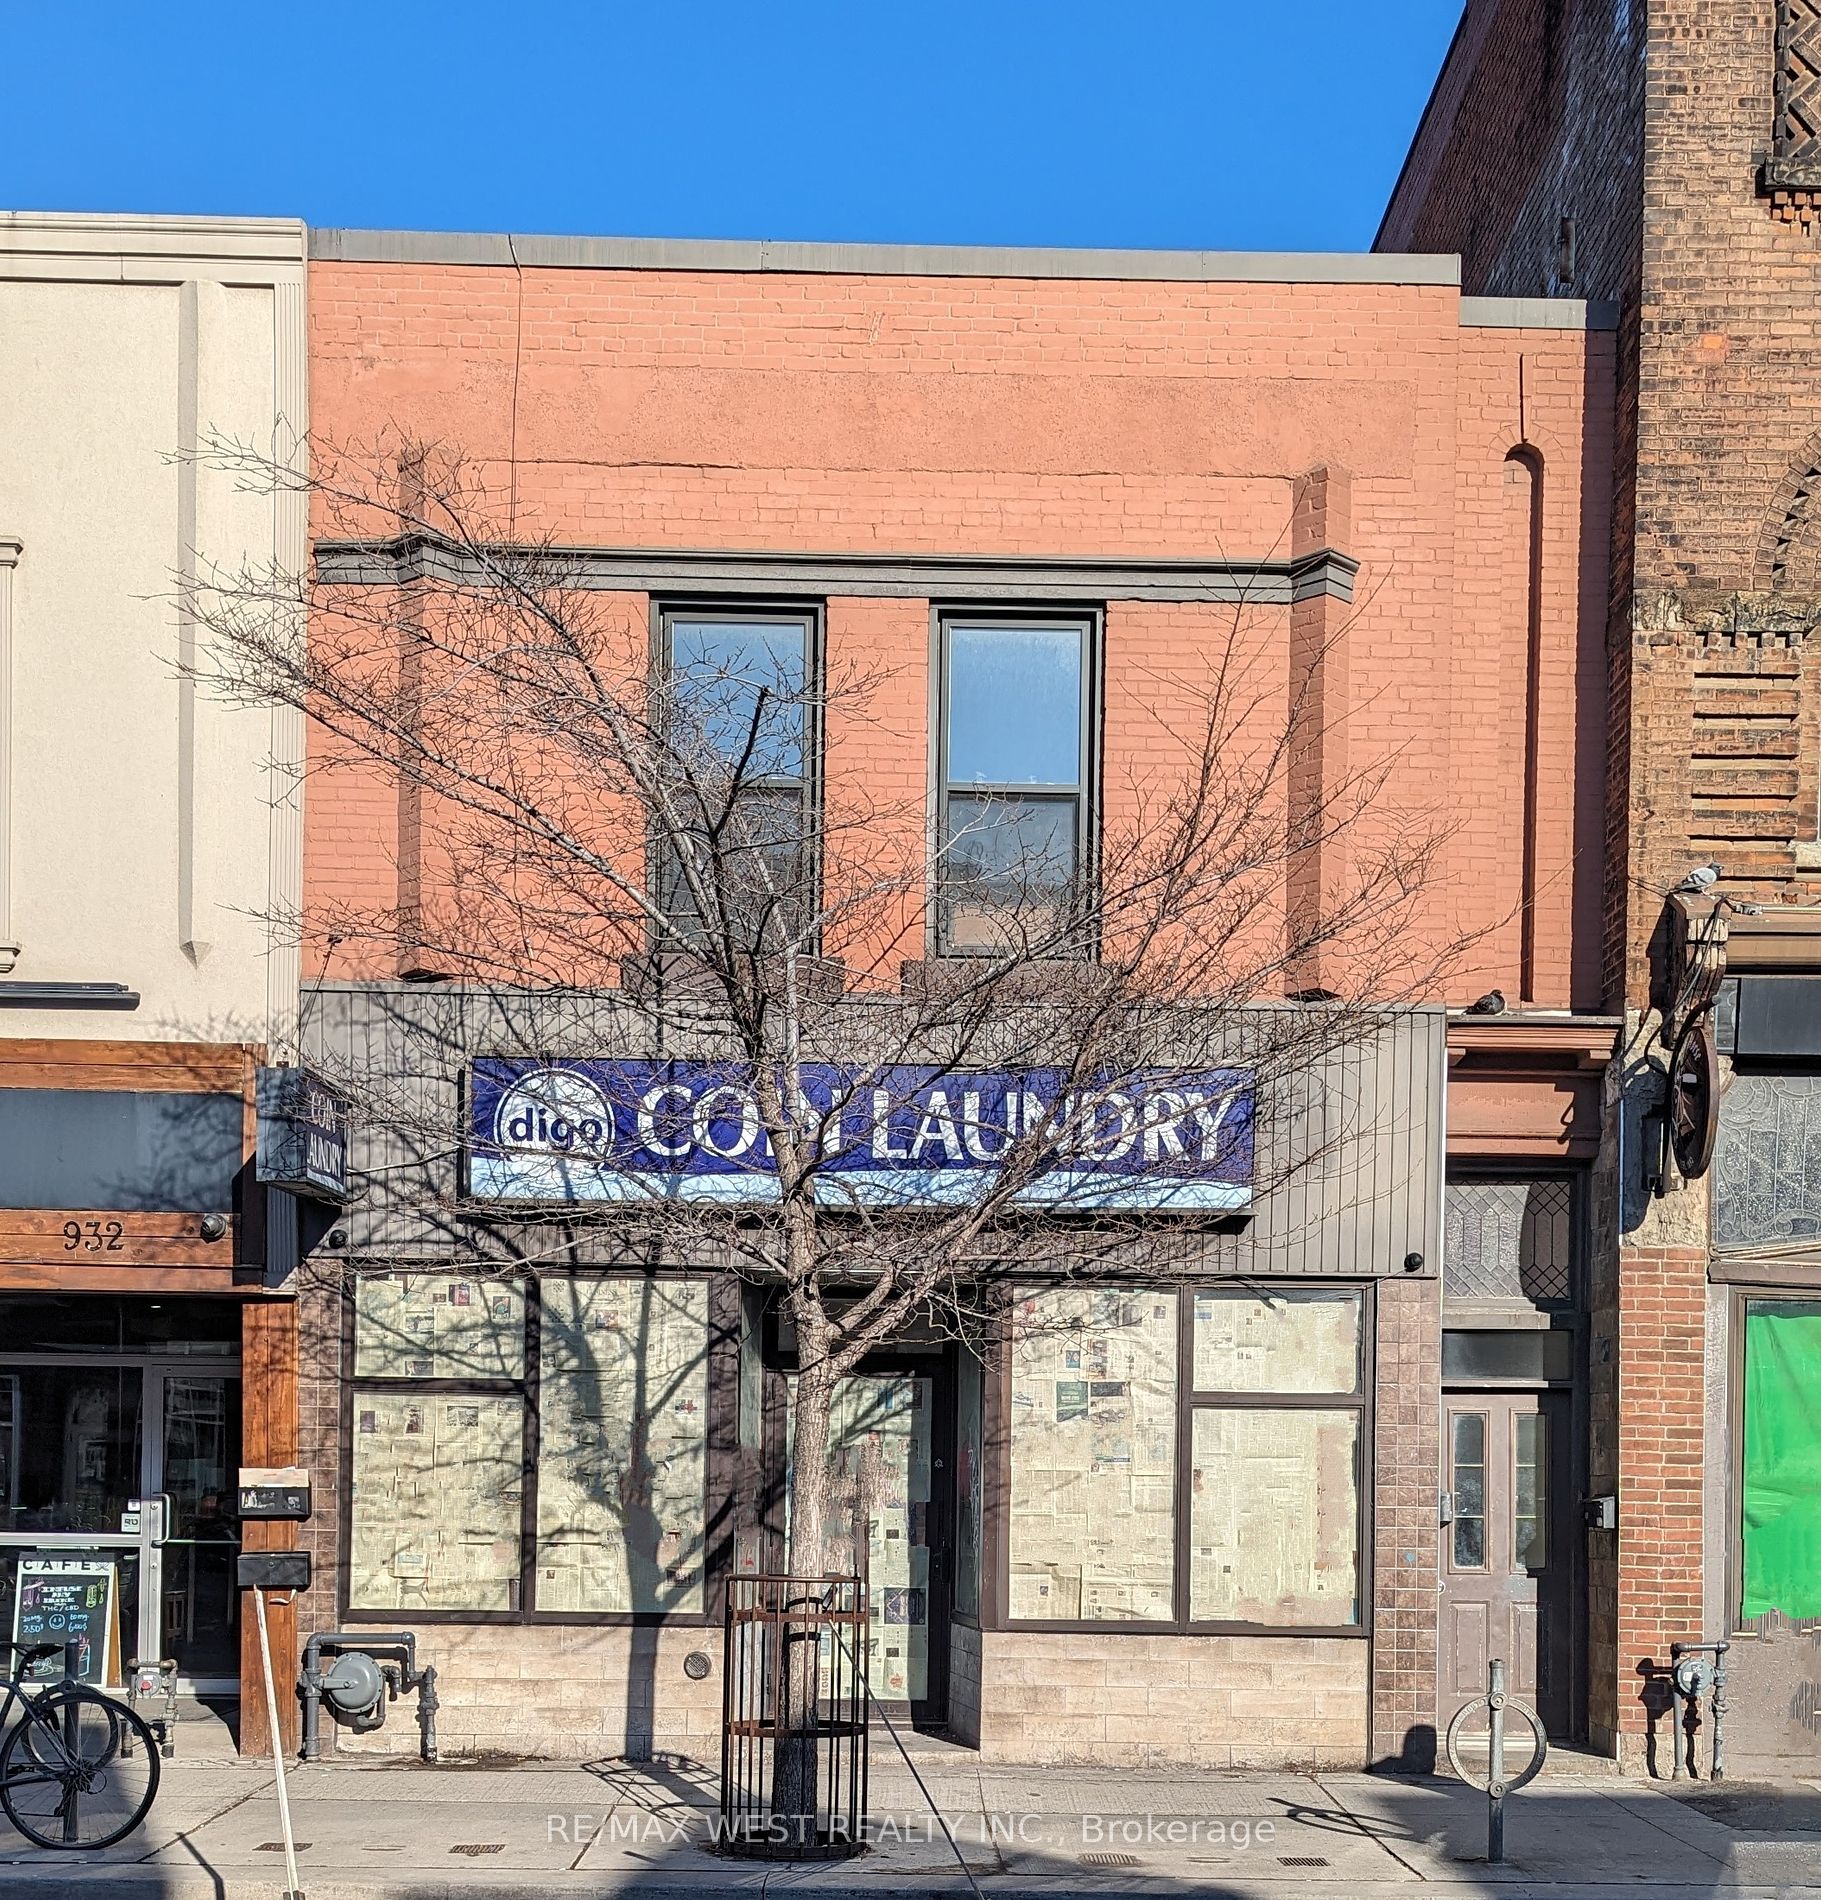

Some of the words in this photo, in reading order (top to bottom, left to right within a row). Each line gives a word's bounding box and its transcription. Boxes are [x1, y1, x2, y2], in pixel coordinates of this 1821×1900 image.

[509, 1107, 602, 1150] digo
[637, 1084, 841, 1158] CON
[872, 1089, 1239, 1163] LAUNDRY
[307, 1132, 343, 1179] AUNDRY
[63, 1220, 124, 1252] 932
[22, 1559, 91, 1571] CAFE
